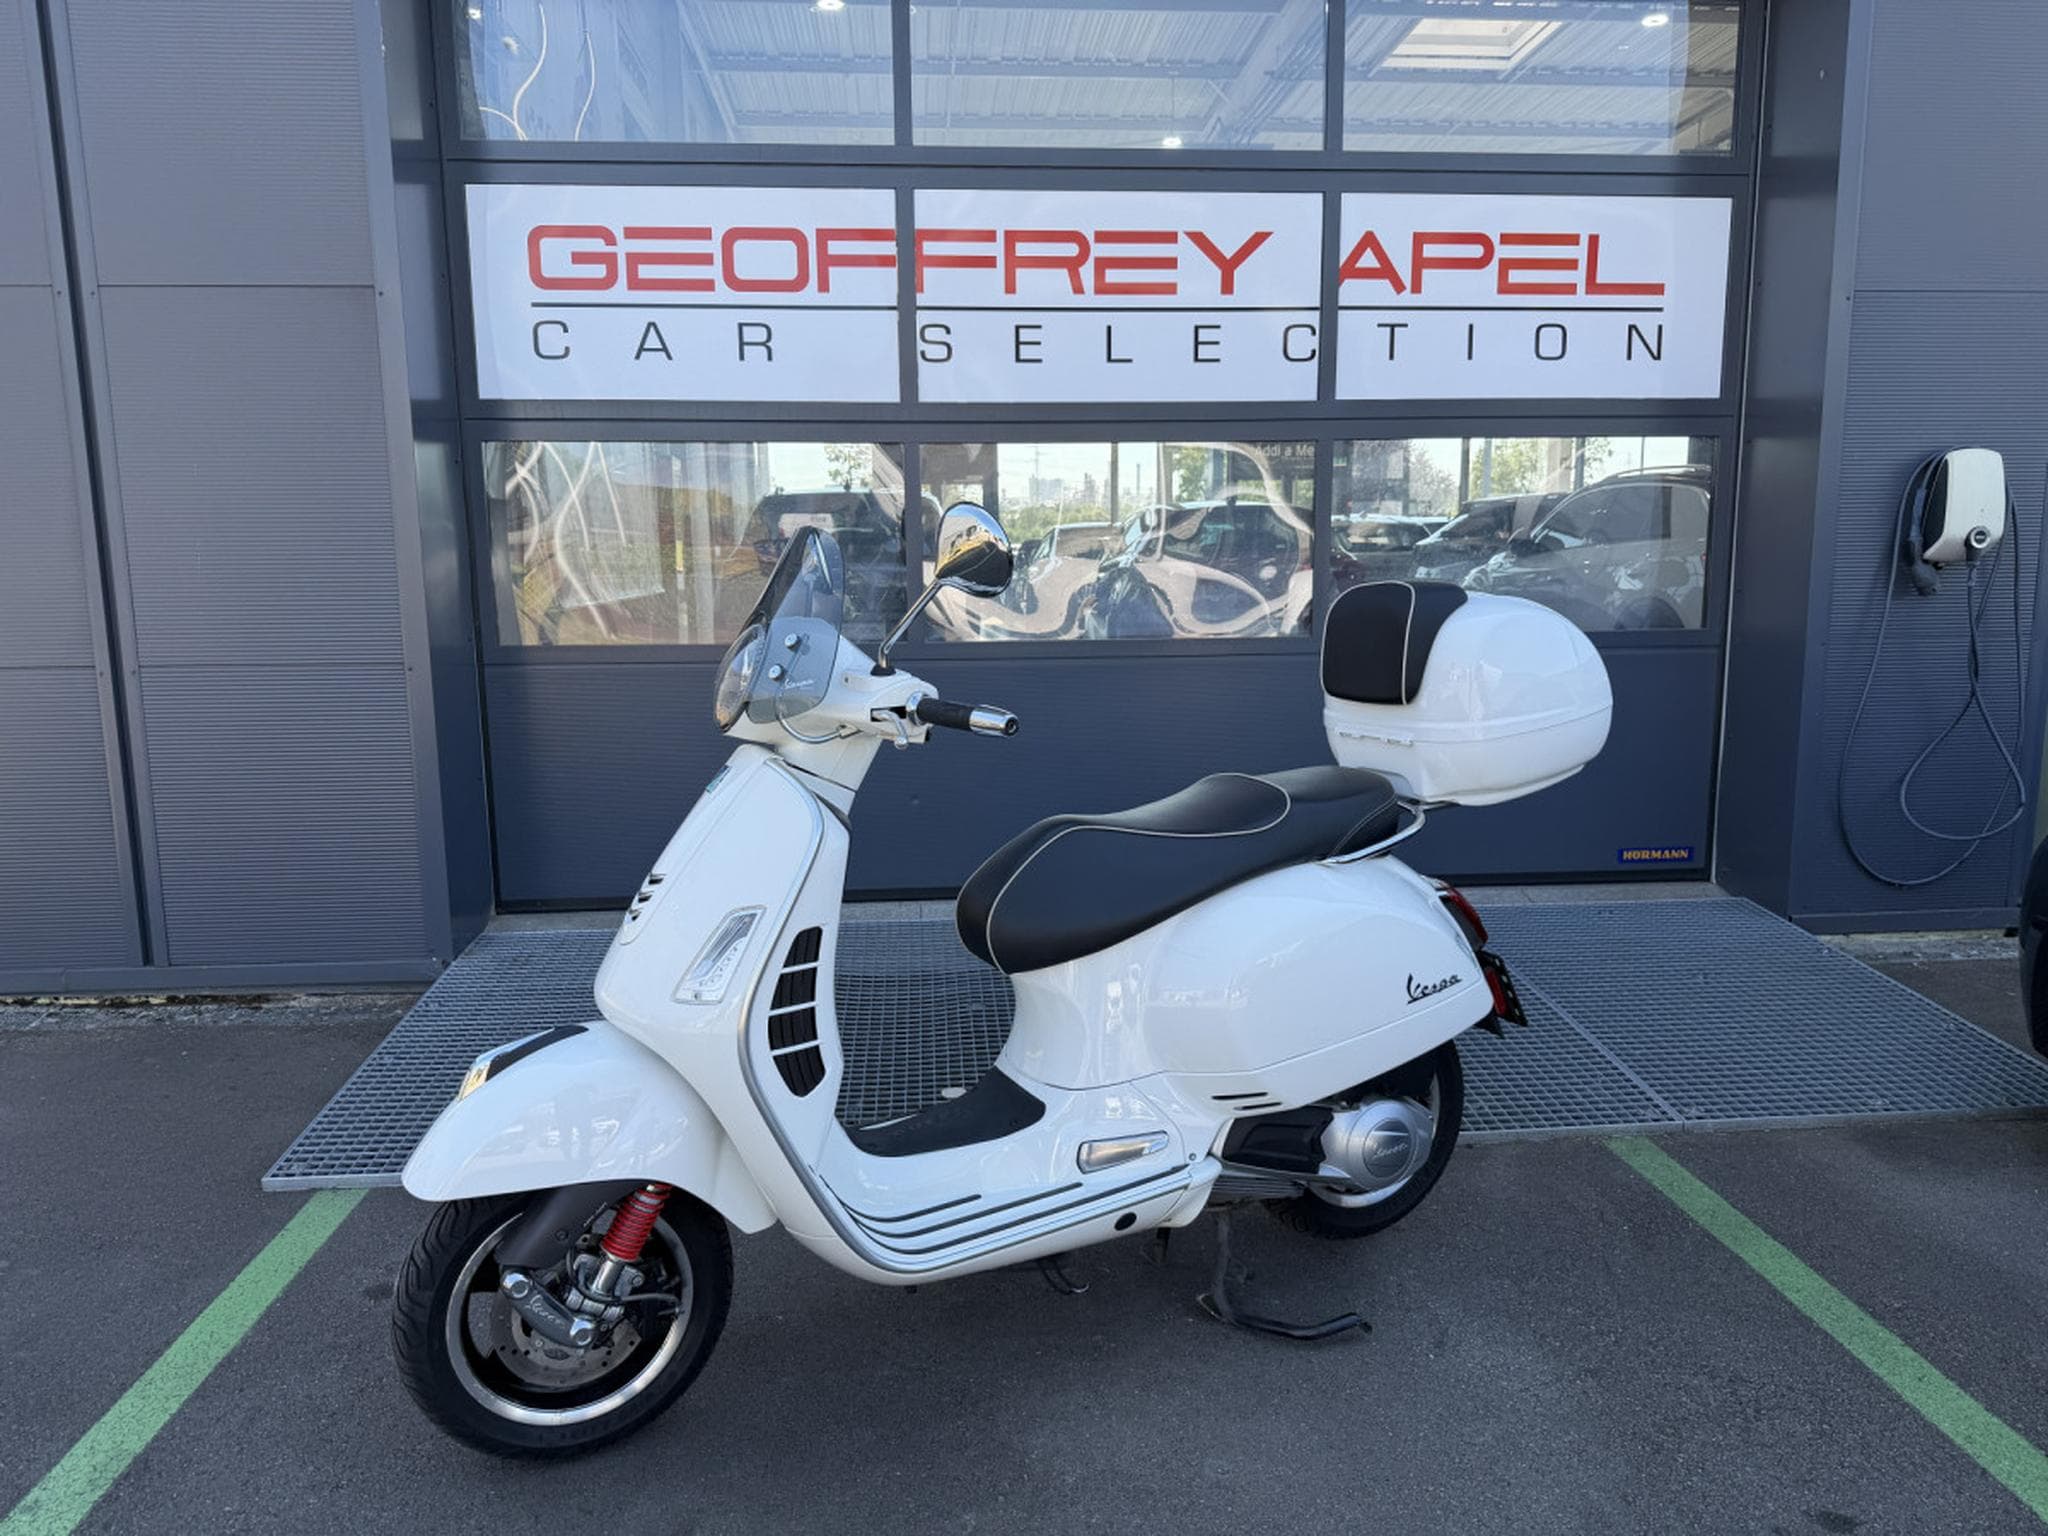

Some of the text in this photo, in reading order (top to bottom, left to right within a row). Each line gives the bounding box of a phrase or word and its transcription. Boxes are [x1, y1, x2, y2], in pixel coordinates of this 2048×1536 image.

[527, 223, 1666, 297] GEOFFREY APEL
[531, 319, 1664, 364] CAR SELECTION
[1406, 972, 1463, 1005] Vespa
